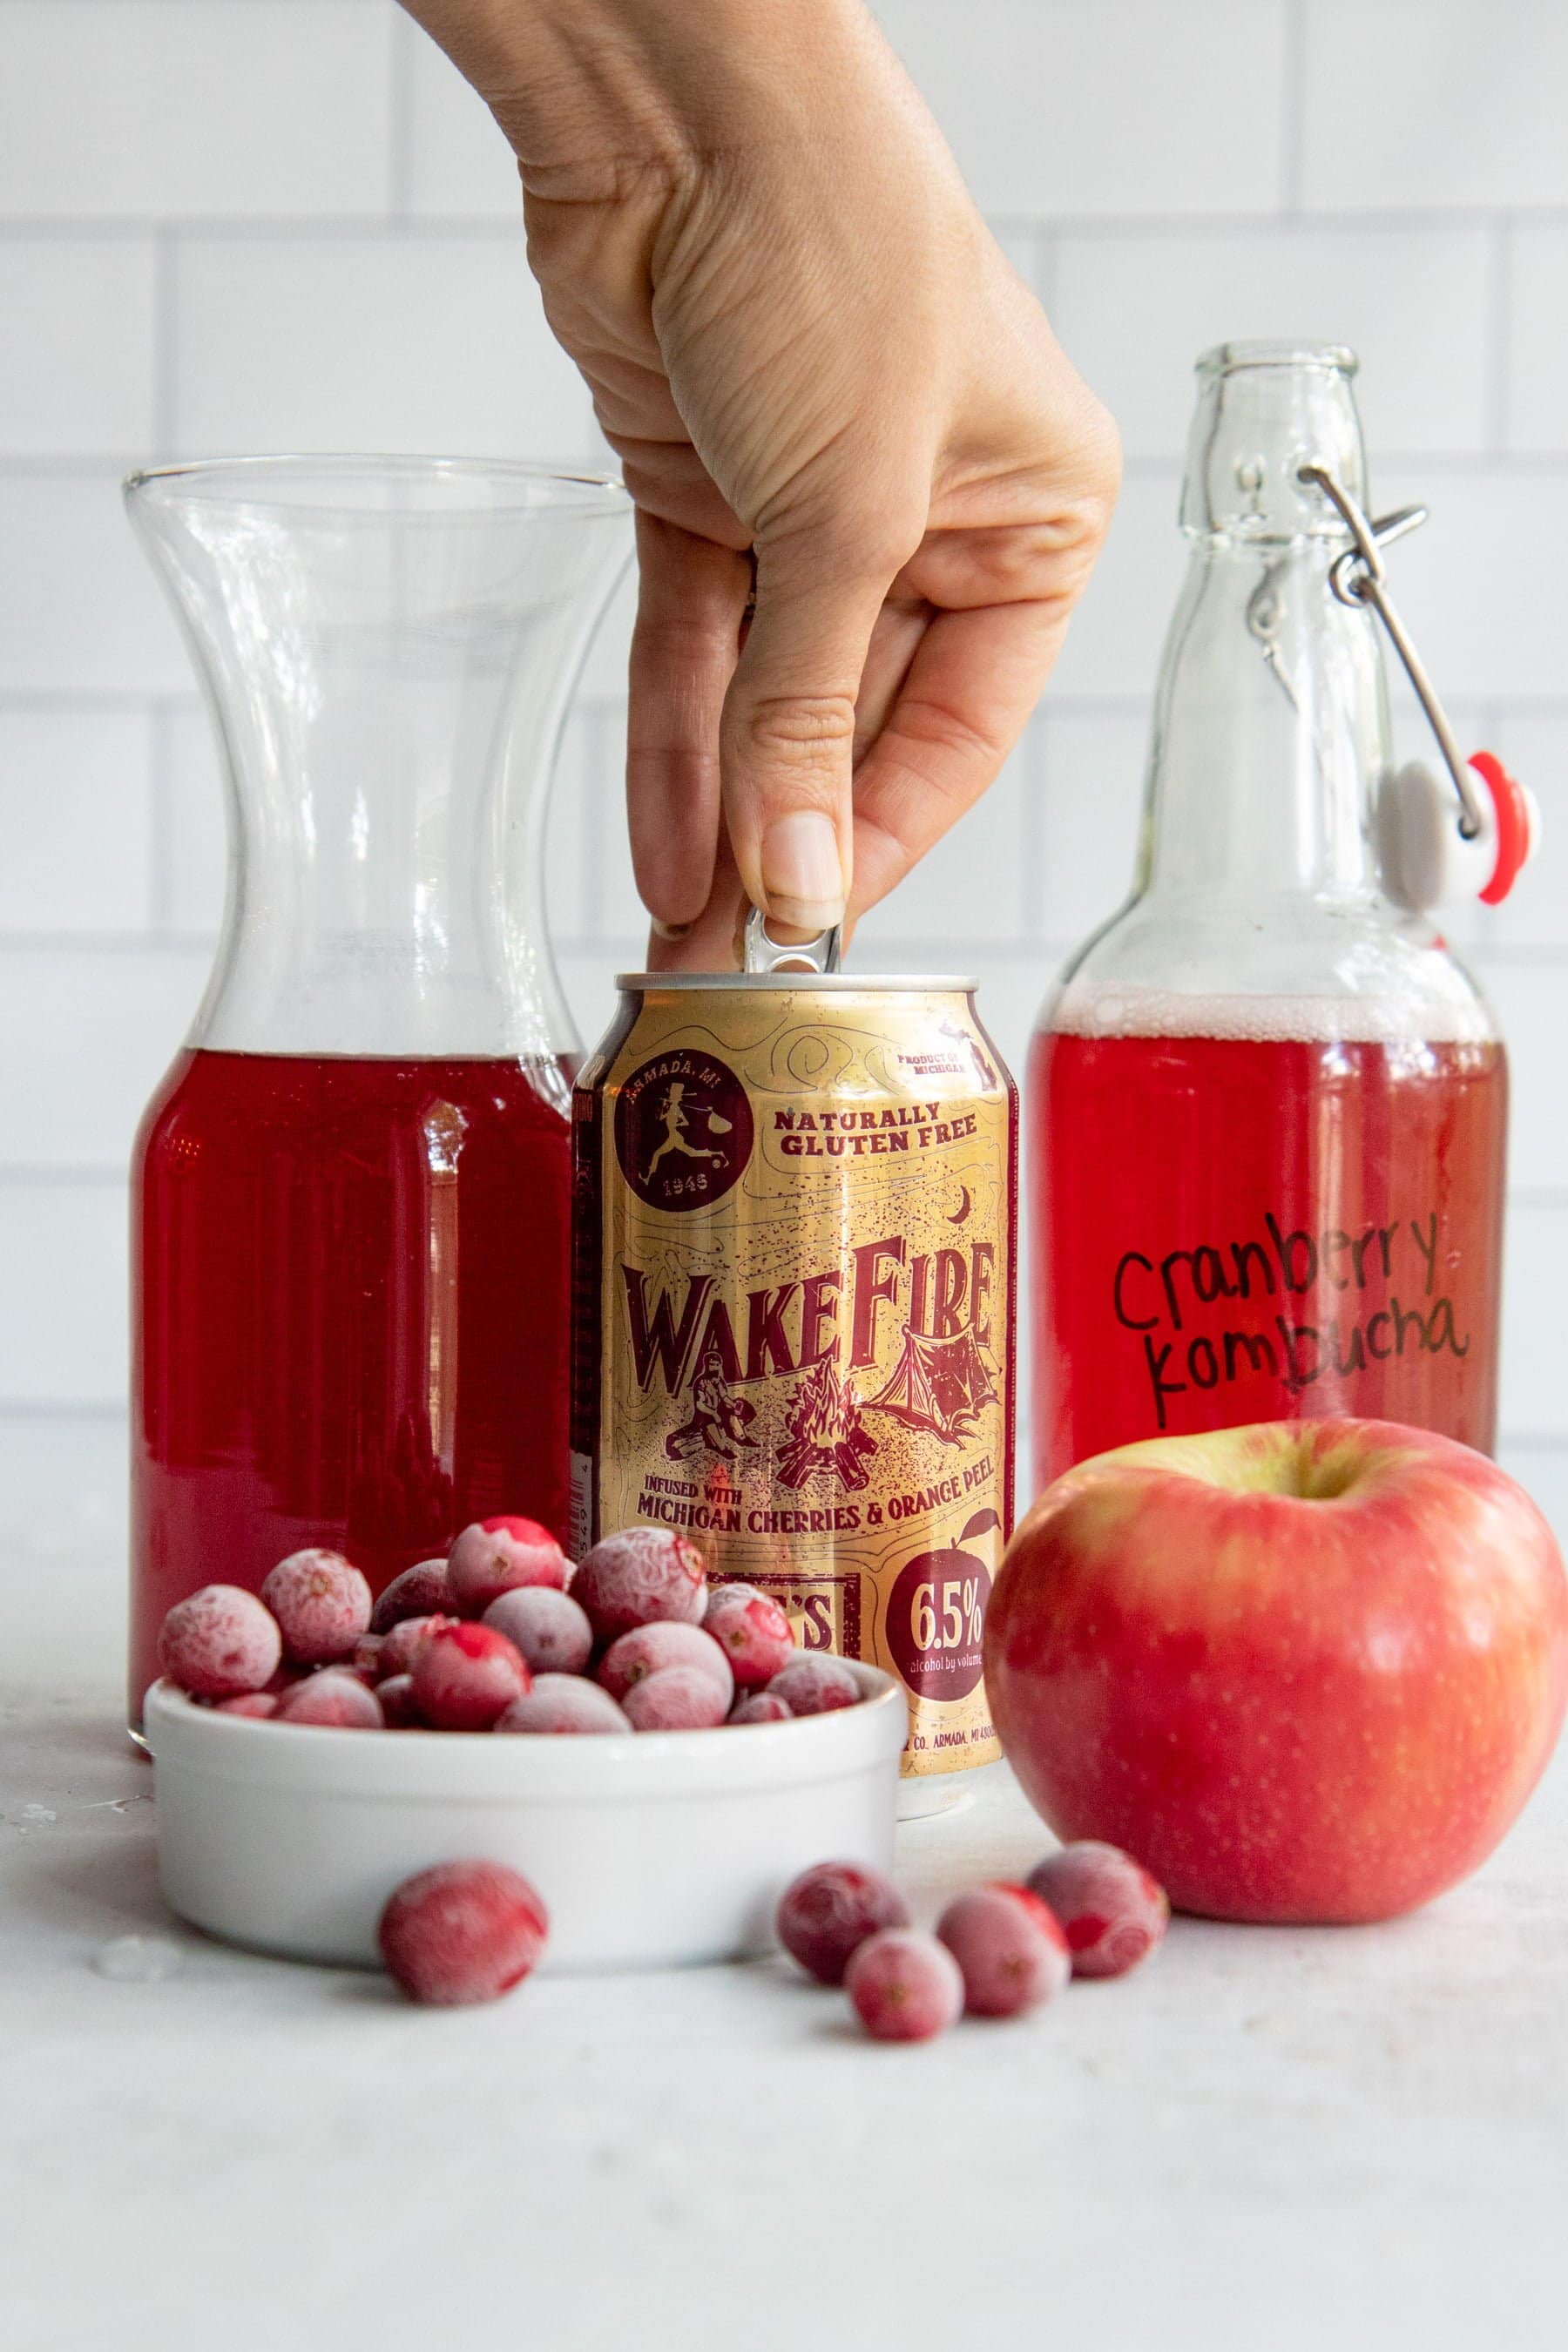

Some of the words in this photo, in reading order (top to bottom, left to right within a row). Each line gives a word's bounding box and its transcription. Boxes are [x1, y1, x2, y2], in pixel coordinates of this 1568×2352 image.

[897, 1052, 946, 1064] PRODUCT
[774, 1102, 941, 1131] NATURALLY
[780, 1130, 909, 1157] GLUTEN
[917, 1113, 978, 1148] FREE
[637, 1493, 741, 1533] MICHIGAN
[747, 1504, 862, 1534] CHERRIES
[867, 1506, 882, 1525] &
[888, 1484, 963, 1523] ORANGE
[963, 1460, 995, 1493] PEEL
[644, 1475, 698, 1499] INFUSED
[704, 1484, 742, 1505] WITH
[910, 1578, 983, 1652] 6.5%
[910, 1656, 943, 1673] alcohol
[945, 1656, 956, 1673] by
